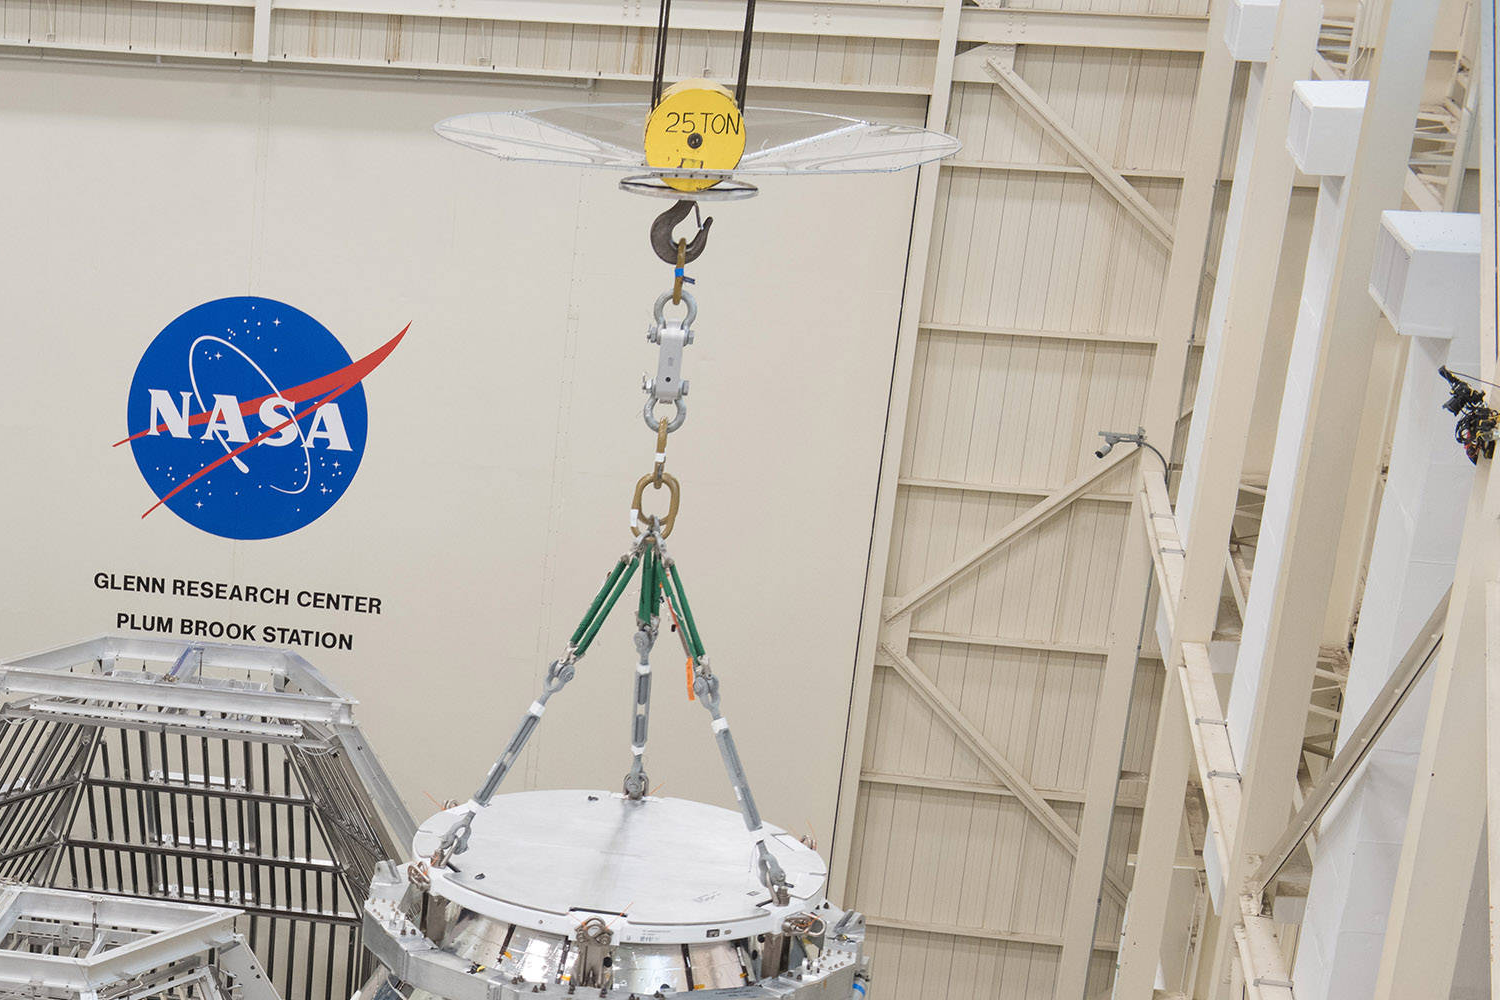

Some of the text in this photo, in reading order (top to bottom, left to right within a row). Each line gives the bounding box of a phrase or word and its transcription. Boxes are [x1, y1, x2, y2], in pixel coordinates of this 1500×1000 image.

[666, 112, 741, 135] 25 TON
[147, 389, 353, 452] NASA
[93, 572, 382, 615] GLENN RESEARCH CENTER
[116, 613, 353, 651] PLUM BROOK STATION
